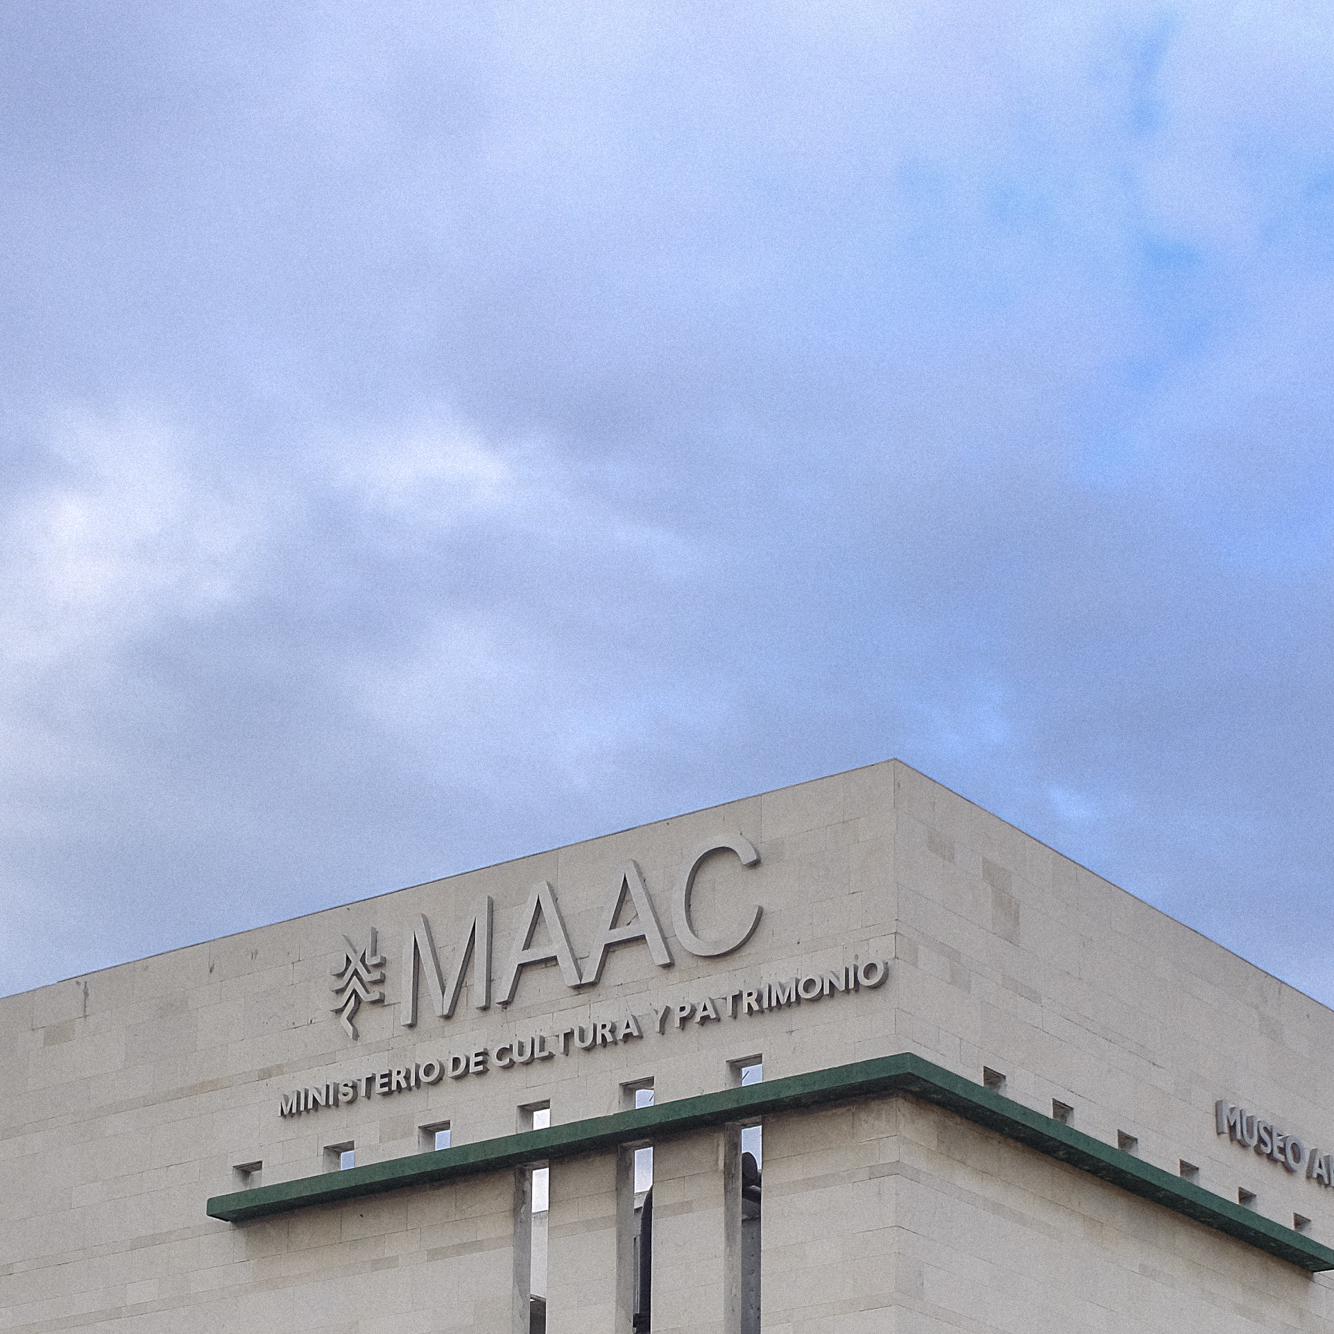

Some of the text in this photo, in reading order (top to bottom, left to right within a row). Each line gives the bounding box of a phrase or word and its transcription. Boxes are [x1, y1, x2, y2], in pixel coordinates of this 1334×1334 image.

[401, 833, 763, 1028] MAAC
[278, 960, 889, 1117] MINISTERIO DE CULTURA Y PATRIMONIO
[1215, 1100, 1305, 1175] MUSEO
